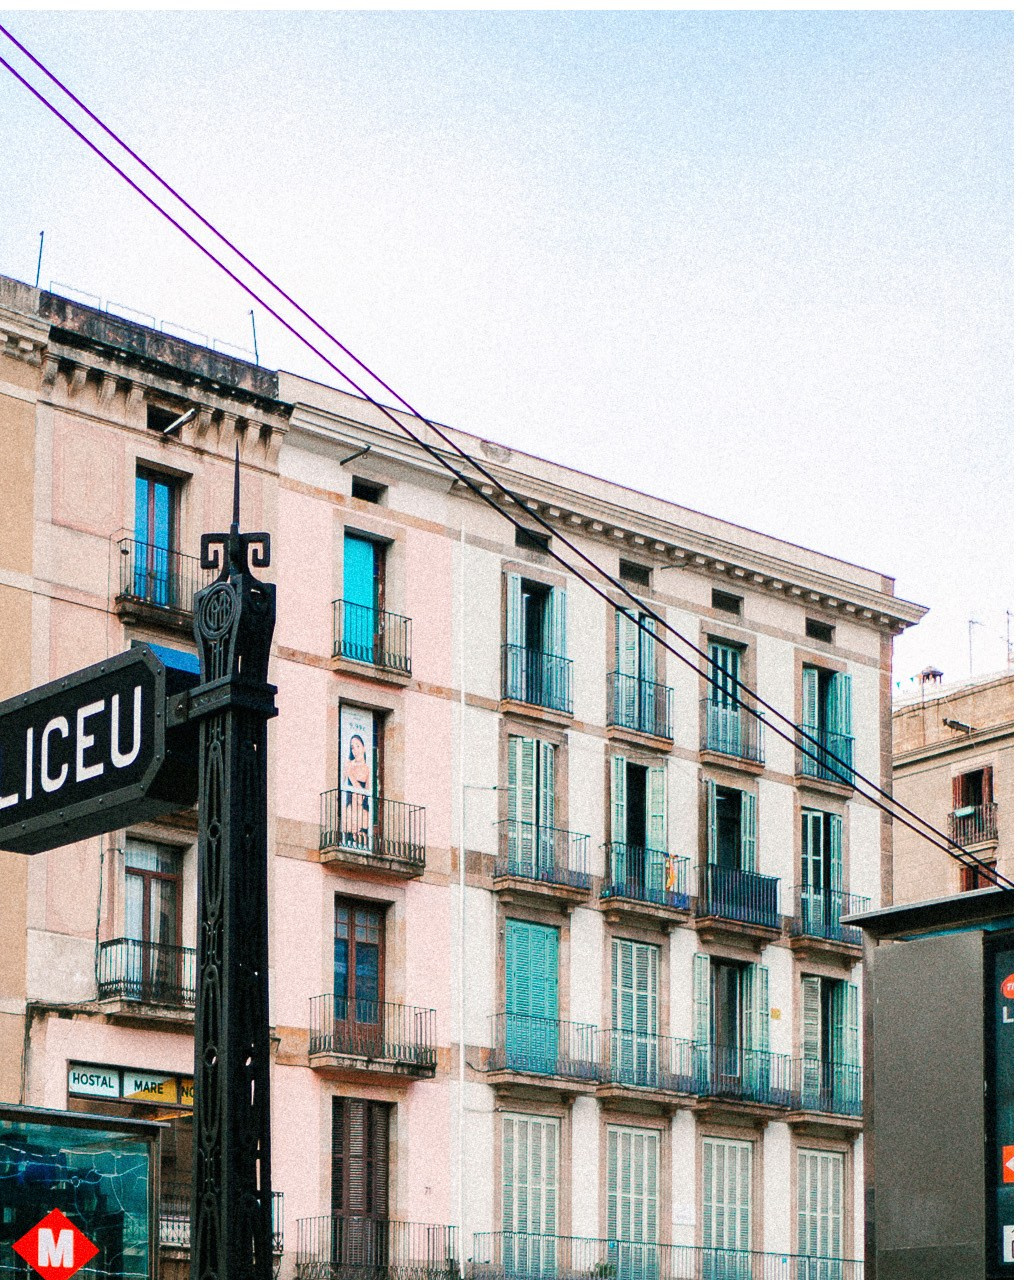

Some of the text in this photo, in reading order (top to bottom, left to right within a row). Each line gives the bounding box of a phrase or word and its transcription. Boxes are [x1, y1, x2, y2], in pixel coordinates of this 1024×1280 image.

[72, 1072, 114, 1089] HOSTAL
[134, 1080, 164, 1095] MARE
[37, 1227, 75, 1269] M
